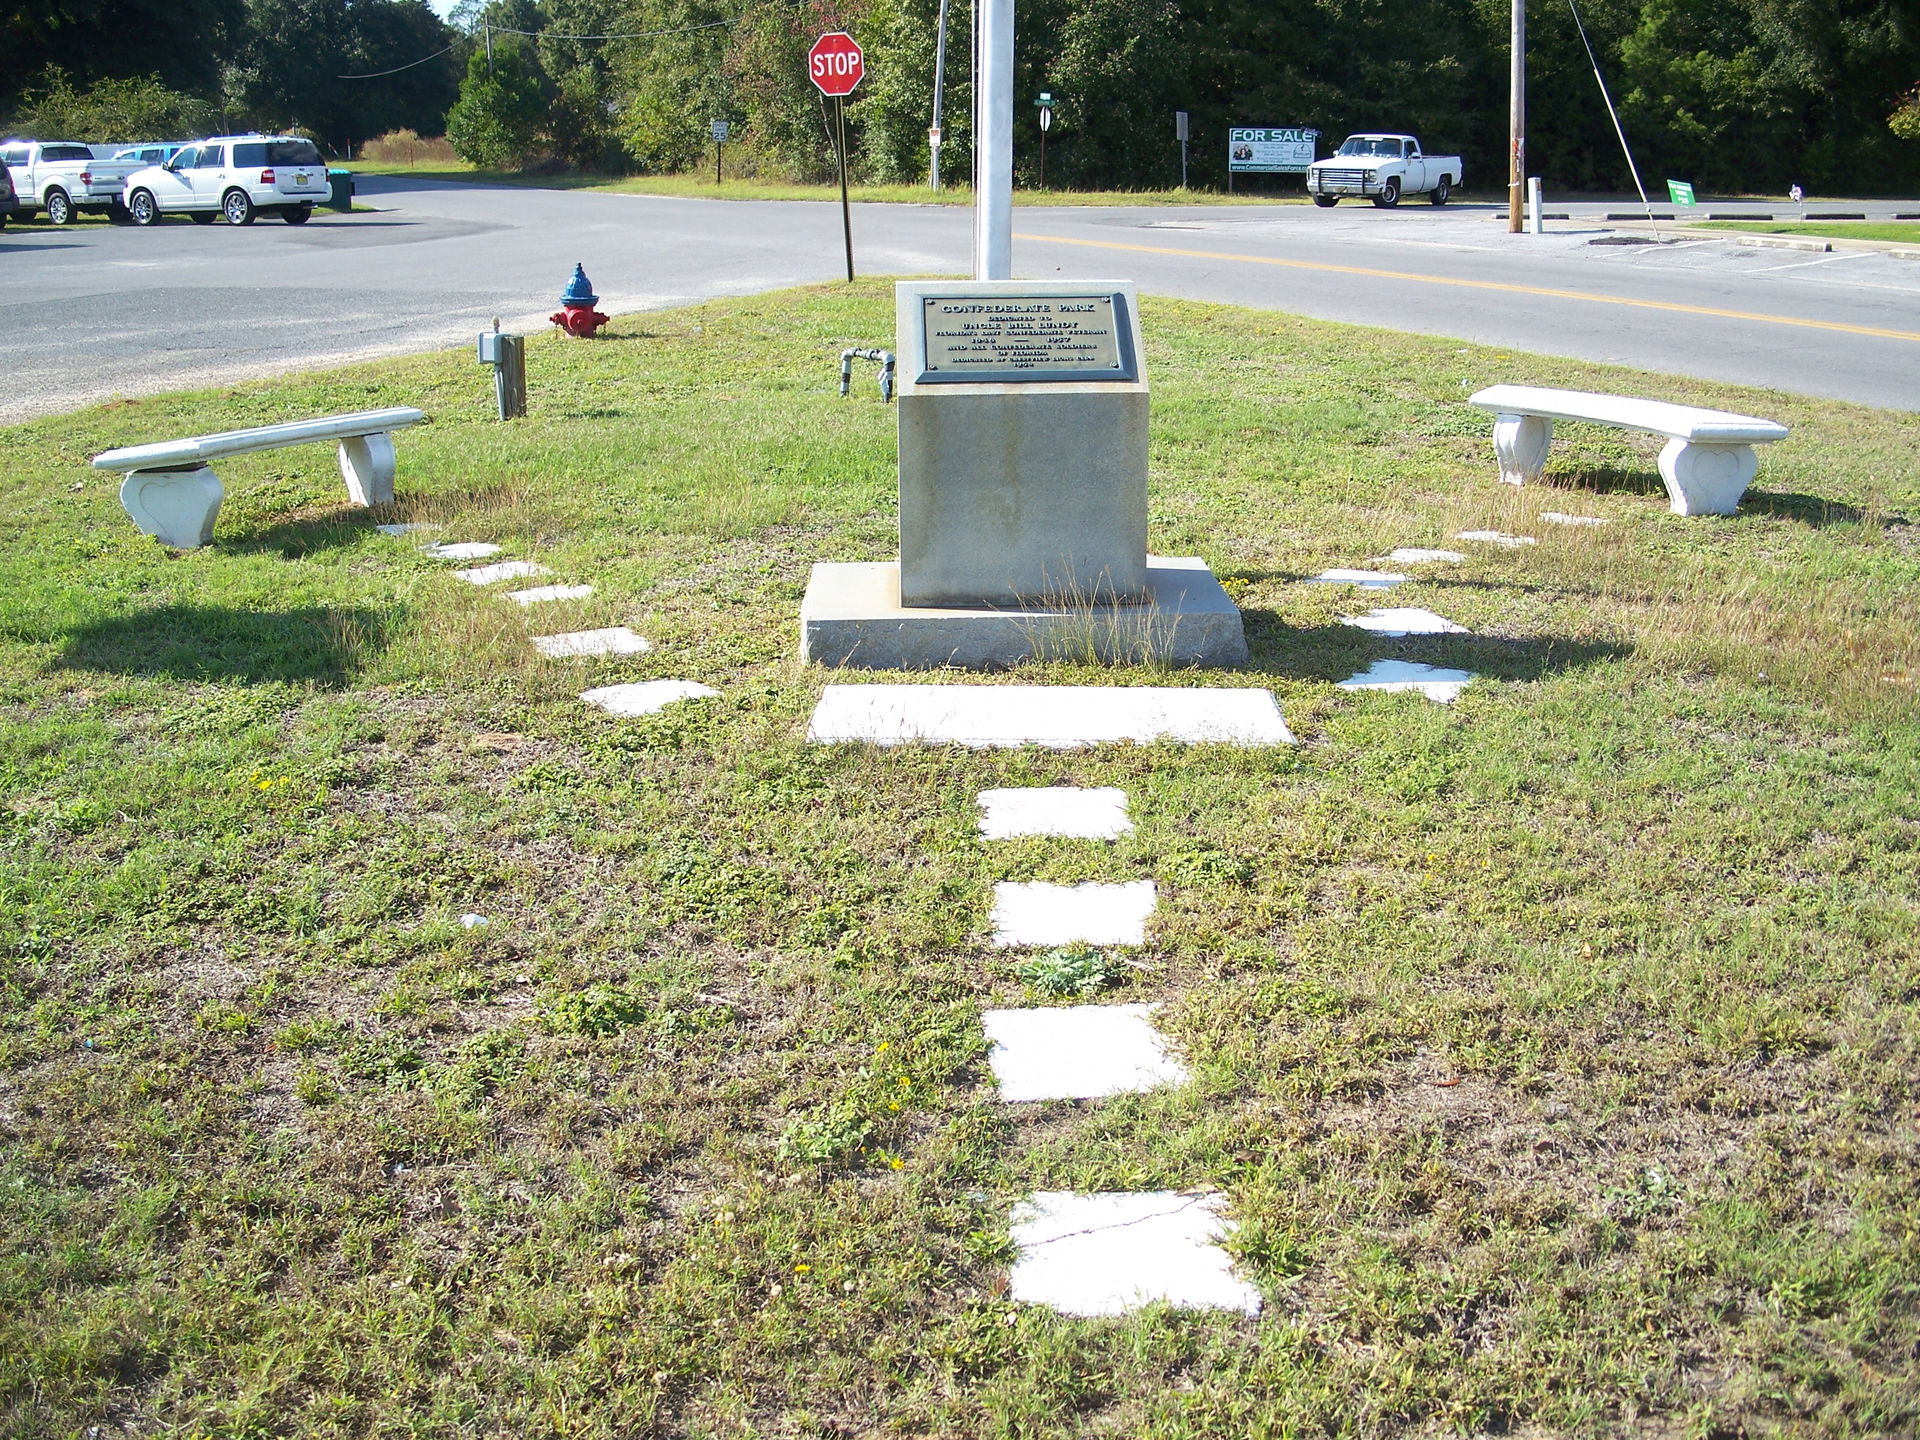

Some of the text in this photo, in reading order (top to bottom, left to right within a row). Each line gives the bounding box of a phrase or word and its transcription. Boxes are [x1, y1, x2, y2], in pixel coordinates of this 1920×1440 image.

[813, 52, 860, 77] STOP
[713, 132, 726, 140] 25
[1232, 130, 1266, 141] FOR
[1271, 130, 1313, 142] SALE
[941, 304, 1096, 313] CONFEDERATE PARK
